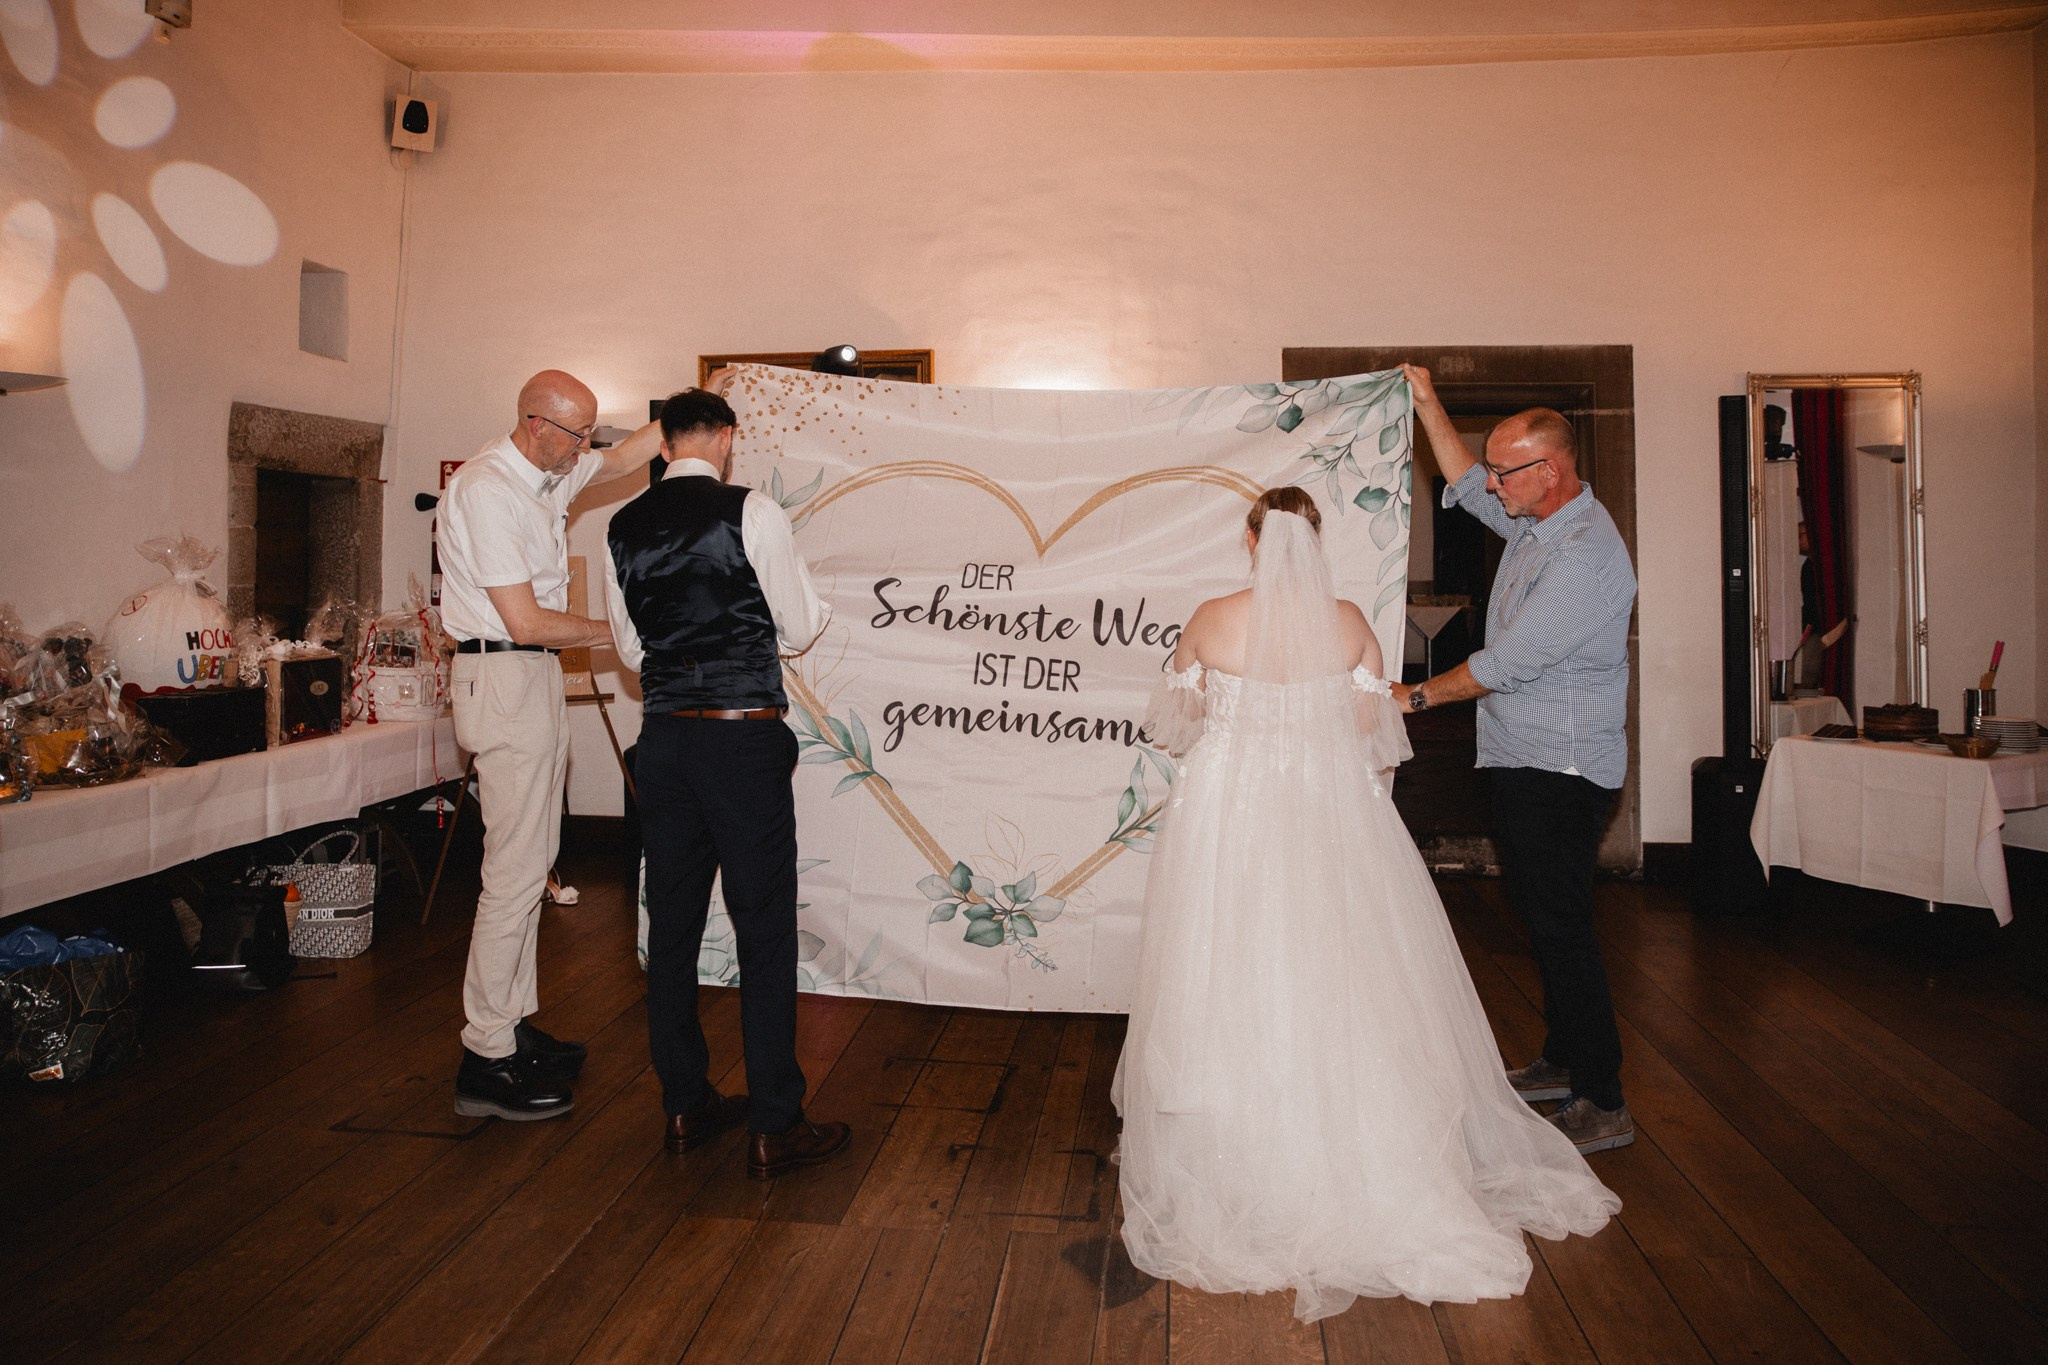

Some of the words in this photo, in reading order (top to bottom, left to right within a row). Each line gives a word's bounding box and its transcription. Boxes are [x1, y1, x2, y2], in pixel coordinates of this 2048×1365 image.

[961, 562, 1015, 591] DER
[871, 577, 1082, 642] Schönste
[1093, 597, 1182, 672] Weg
[973, 652, 1016, 687] IST
[1023, 656, 1081, 692] DER
[883, 700, 1157, 753] gemeinsame
[311, 908, 335, 920] DIOR
